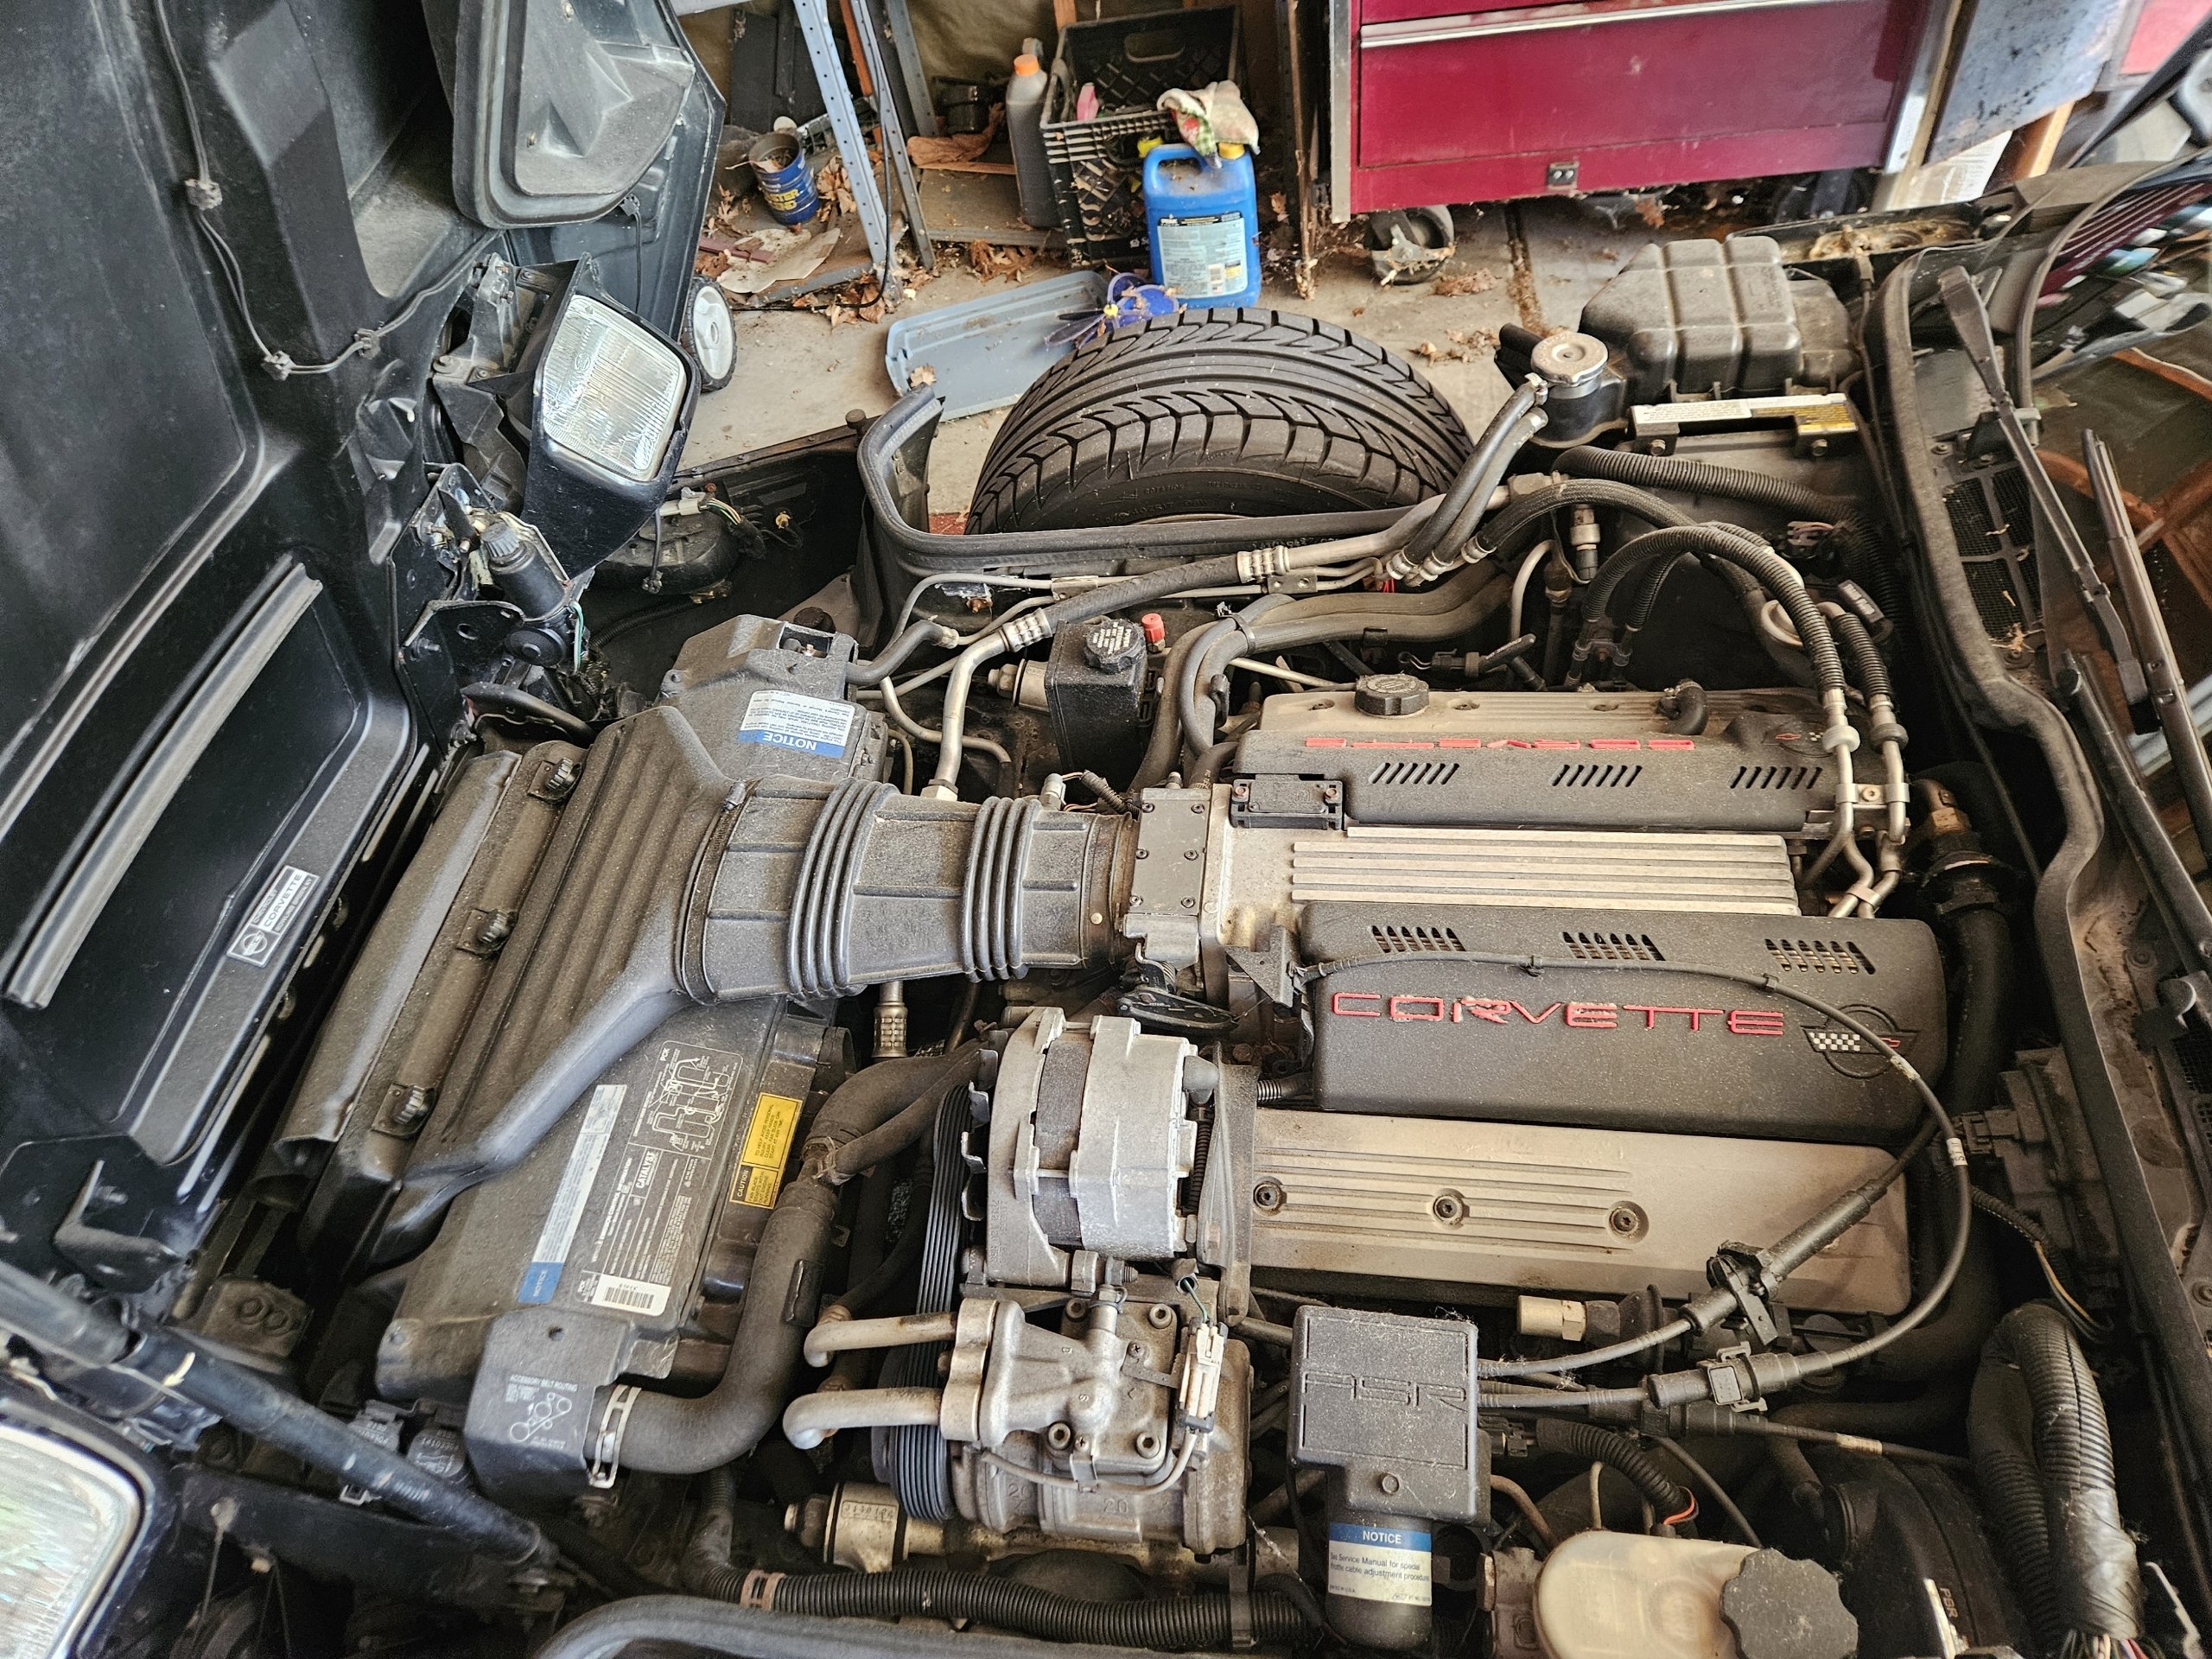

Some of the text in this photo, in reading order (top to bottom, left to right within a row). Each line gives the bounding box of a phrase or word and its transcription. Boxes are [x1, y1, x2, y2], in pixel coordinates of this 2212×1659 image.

[762, 731, 817, 750] NOTICE
[264, 874, 302, 927] CORVETTE
[1332, 992, 1785, 1036] CORVETTE
[658, 1046, 670, 1062] PCK
[635, 1150, 656, 1189] CATALYST
[737, 1169, 748, 1197] CAUTION
[607, 1191, 621, 1215] CONTROL
[1363, 1530, 1402, 1545] NOTICE
[1338, 1554, 1359, 1563] Service
[1361, 1556, 1387, 1567] Manual
[1400, 1561, 1420, 1572] special
[1344, 1565, 1362, 1573] cable
[1363, 1567, 1402, 1580] adjustment
[1939, 1586, 1958, 1618] PBR
